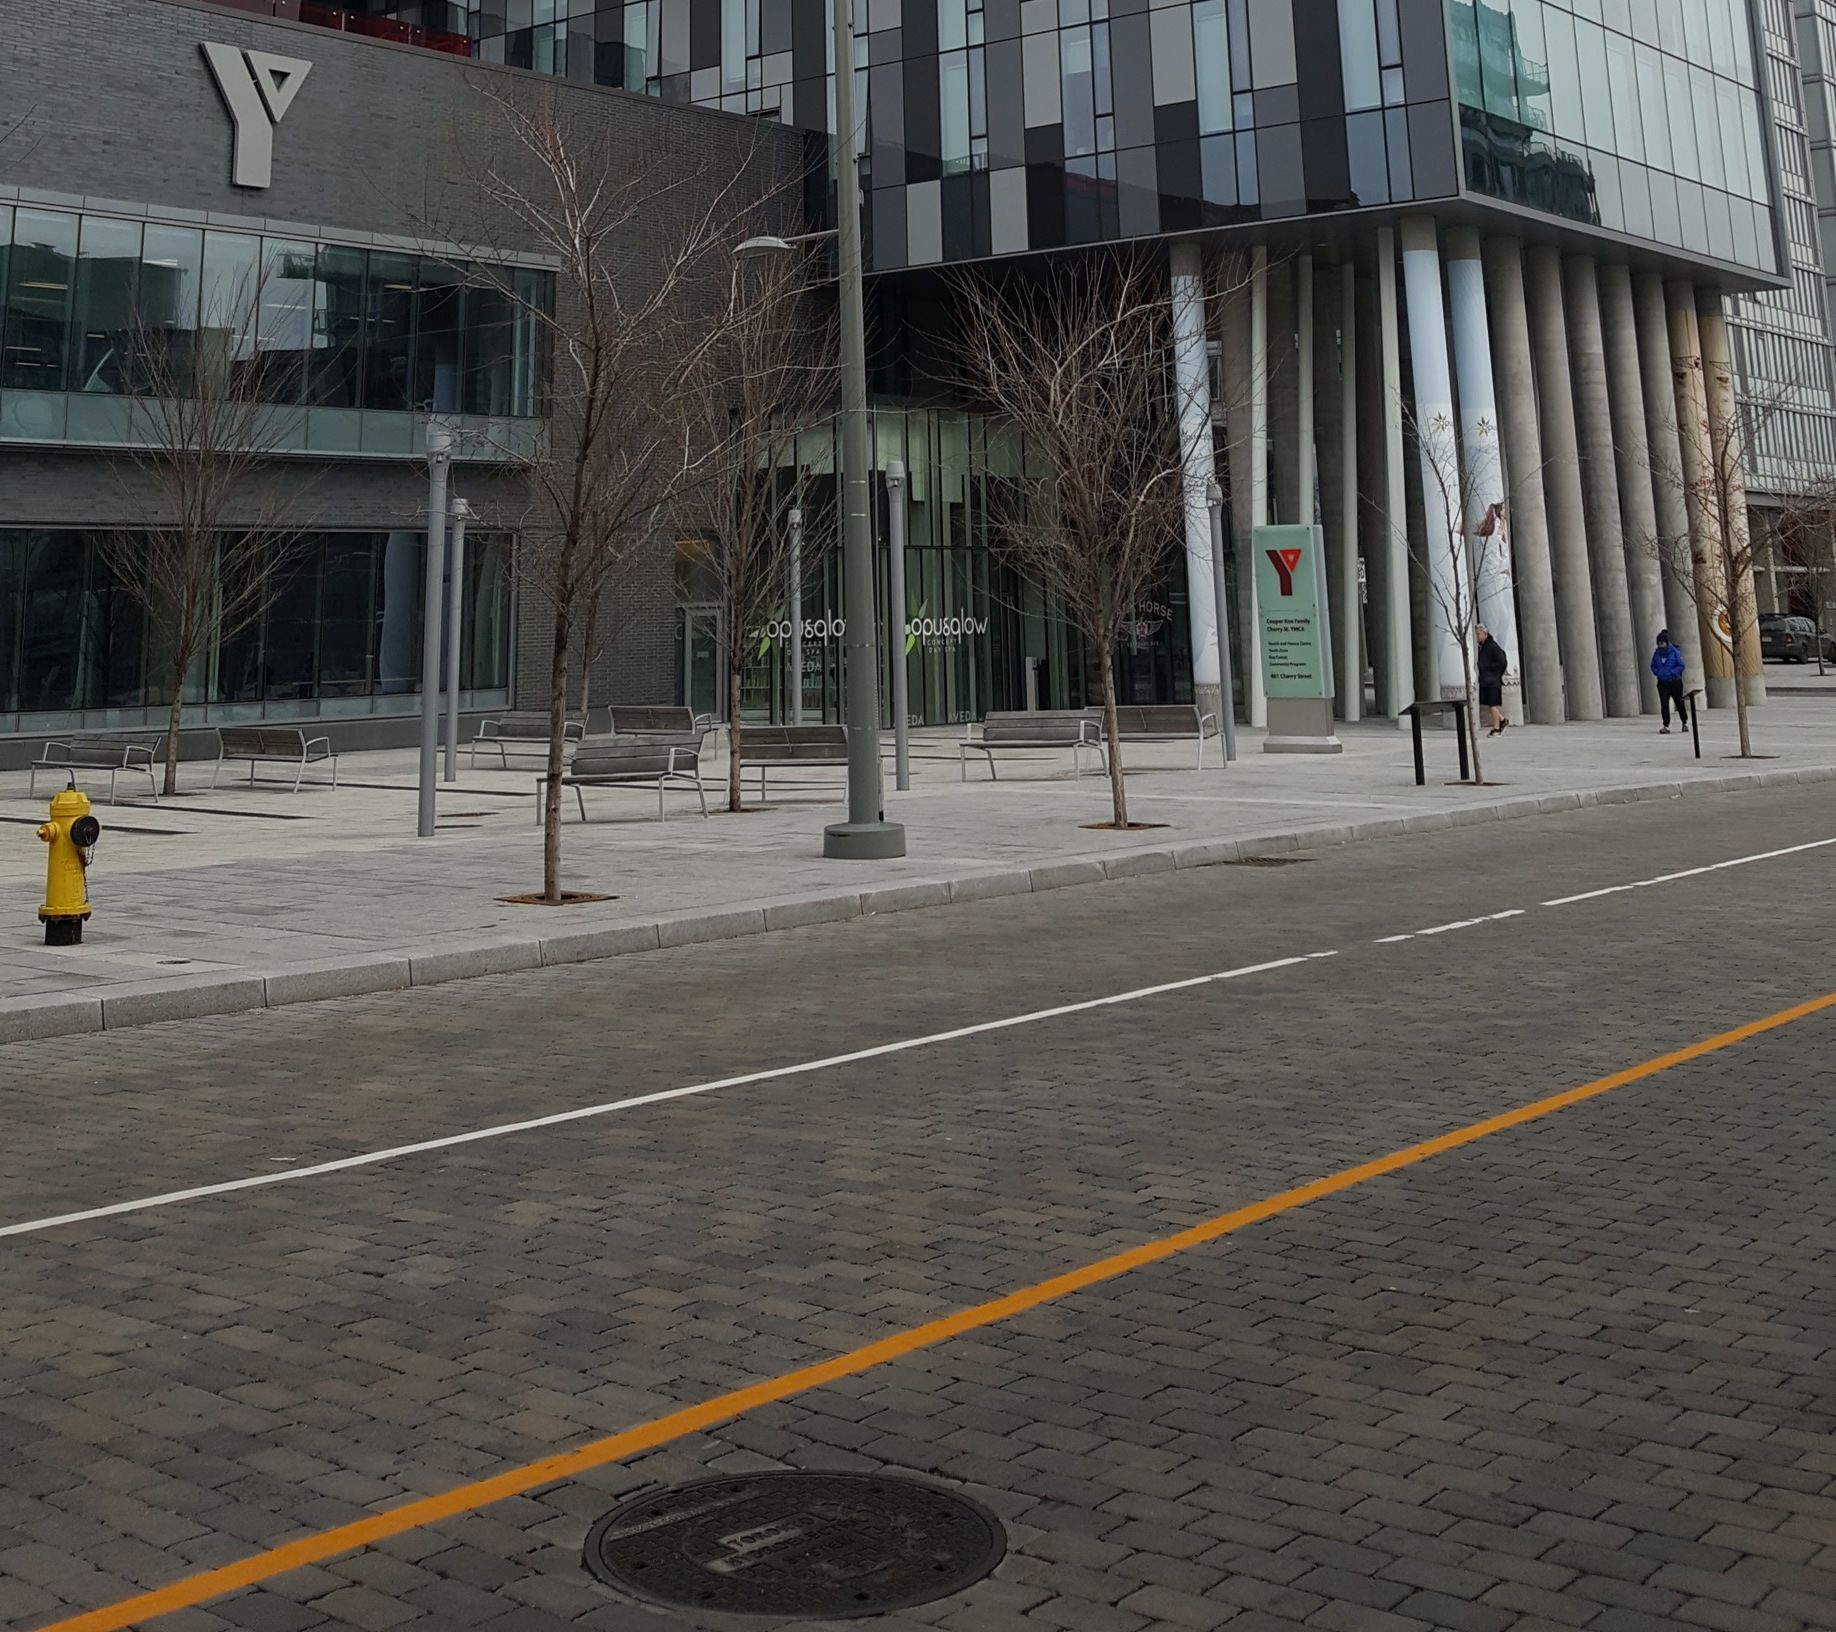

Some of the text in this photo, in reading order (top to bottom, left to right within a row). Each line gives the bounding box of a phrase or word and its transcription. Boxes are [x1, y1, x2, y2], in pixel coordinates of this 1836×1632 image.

[1139, 599, 1174, 621] HORSE
[785, 660, 823, 673] AEDA
[948, 710, 978, 724] AVEDA
